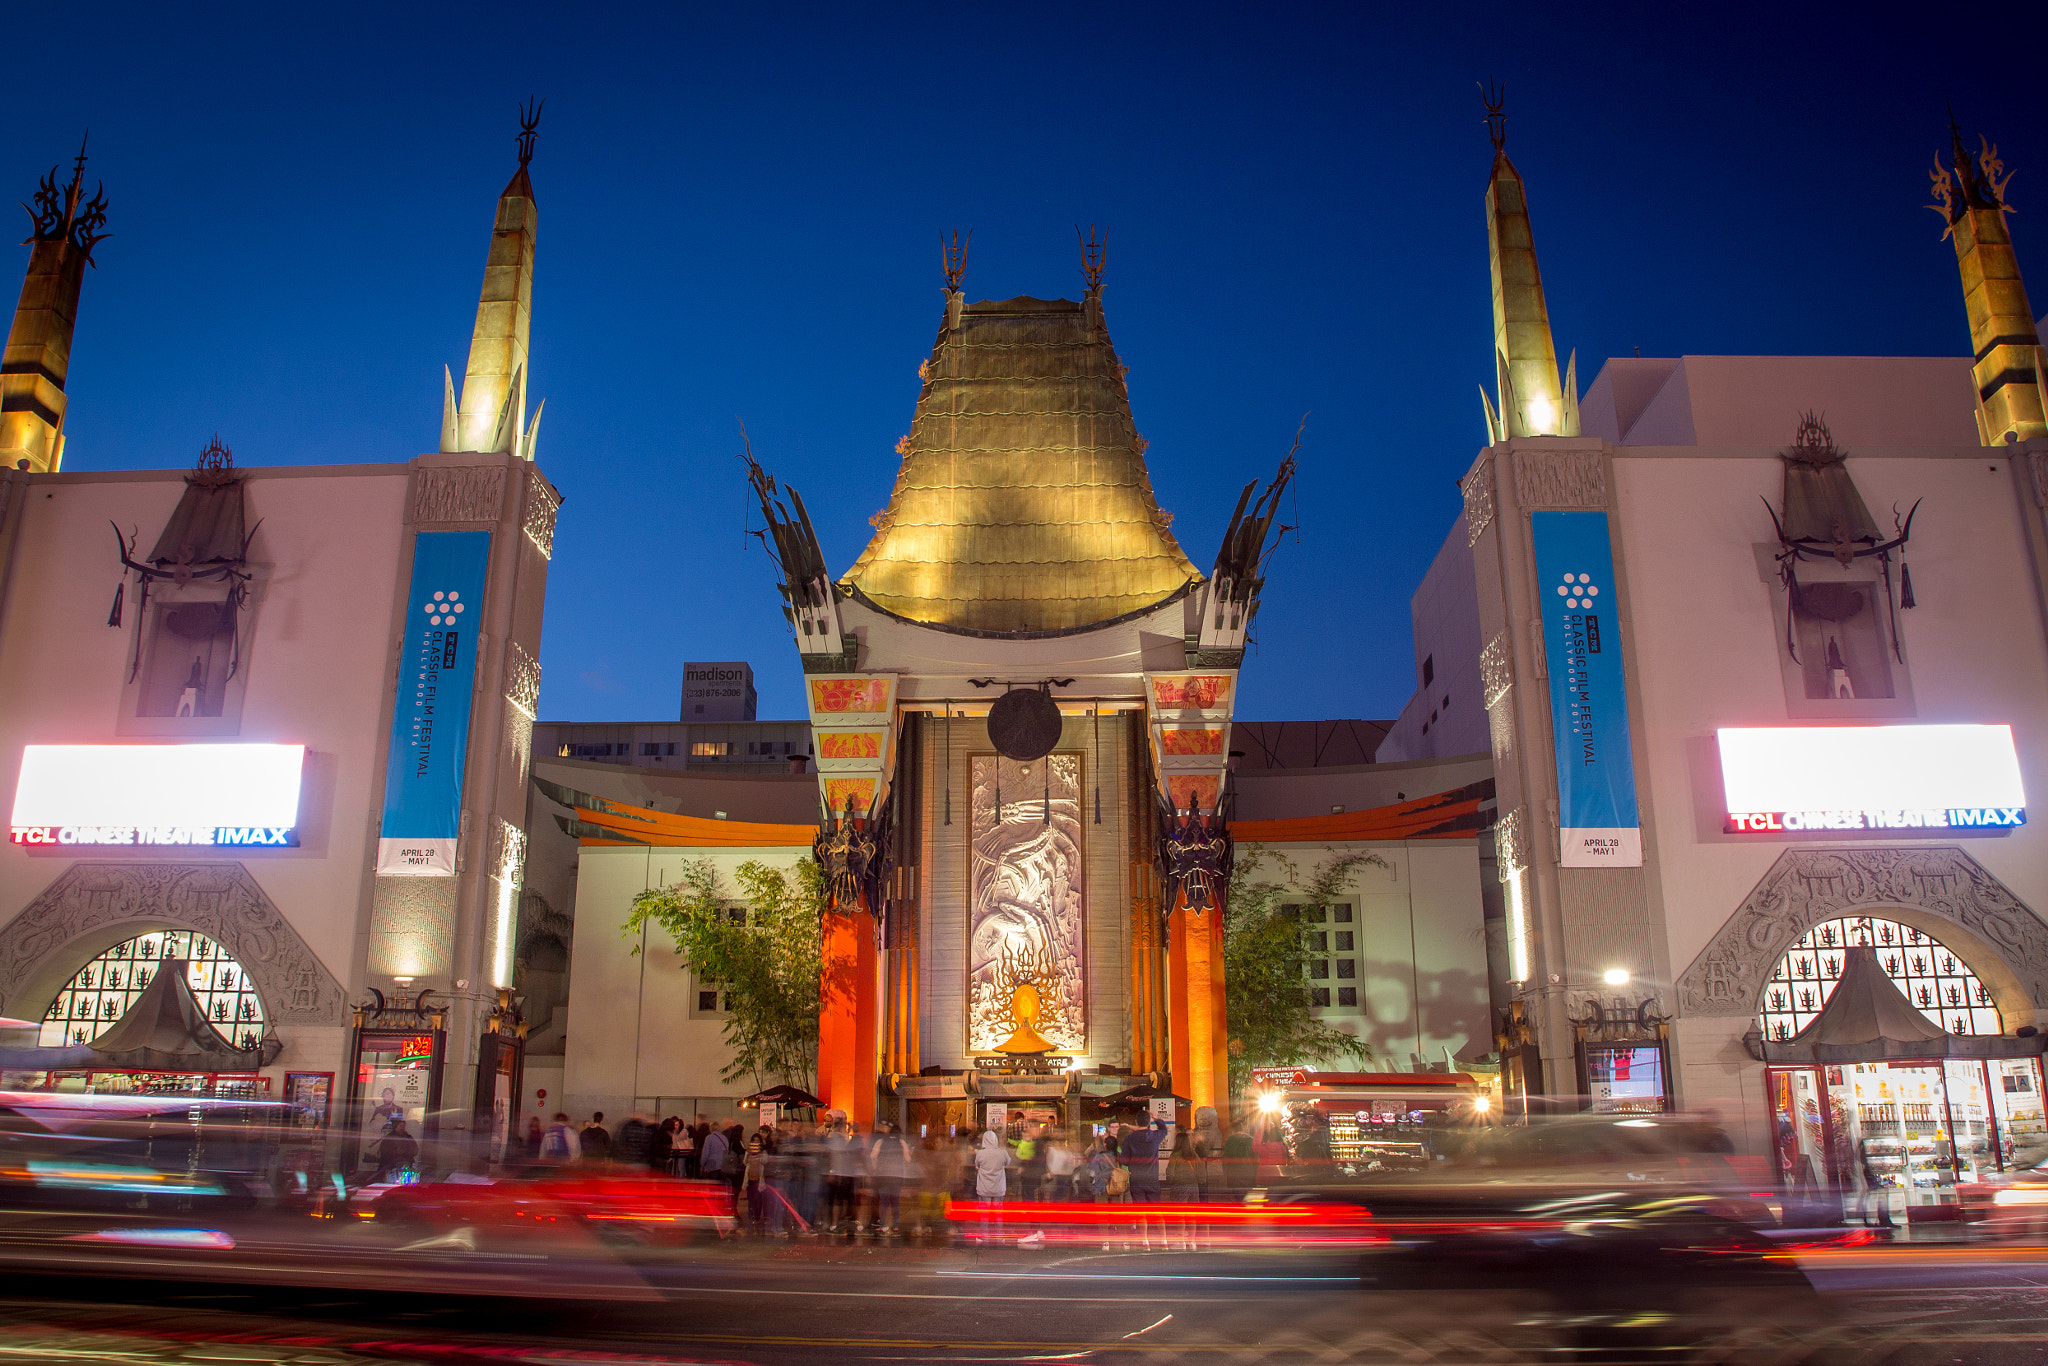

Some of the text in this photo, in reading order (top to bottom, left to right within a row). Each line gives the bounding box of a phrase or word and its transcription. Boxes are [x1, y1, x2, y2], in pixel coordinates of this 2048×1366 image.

[1588, 617, 1598, 652] TCM
[411, 632, 431, 746] HOLLYWOOD 2016
[417, 631, 442, 779] CLASSIC FILM FESTIVAL
[687, 667, 742, 680] madison
[1563, 615, 1580, 733] HOLLYWOOD 2016
[1572, 614, 1595, 767] CLASSIC FILM FESTIVAL
[11, 826, 288, 845] TCL CHINESE THEATRE IMAX
[1730, 808, 2022, 830] TCL CHINESE THEATRE IMAX
